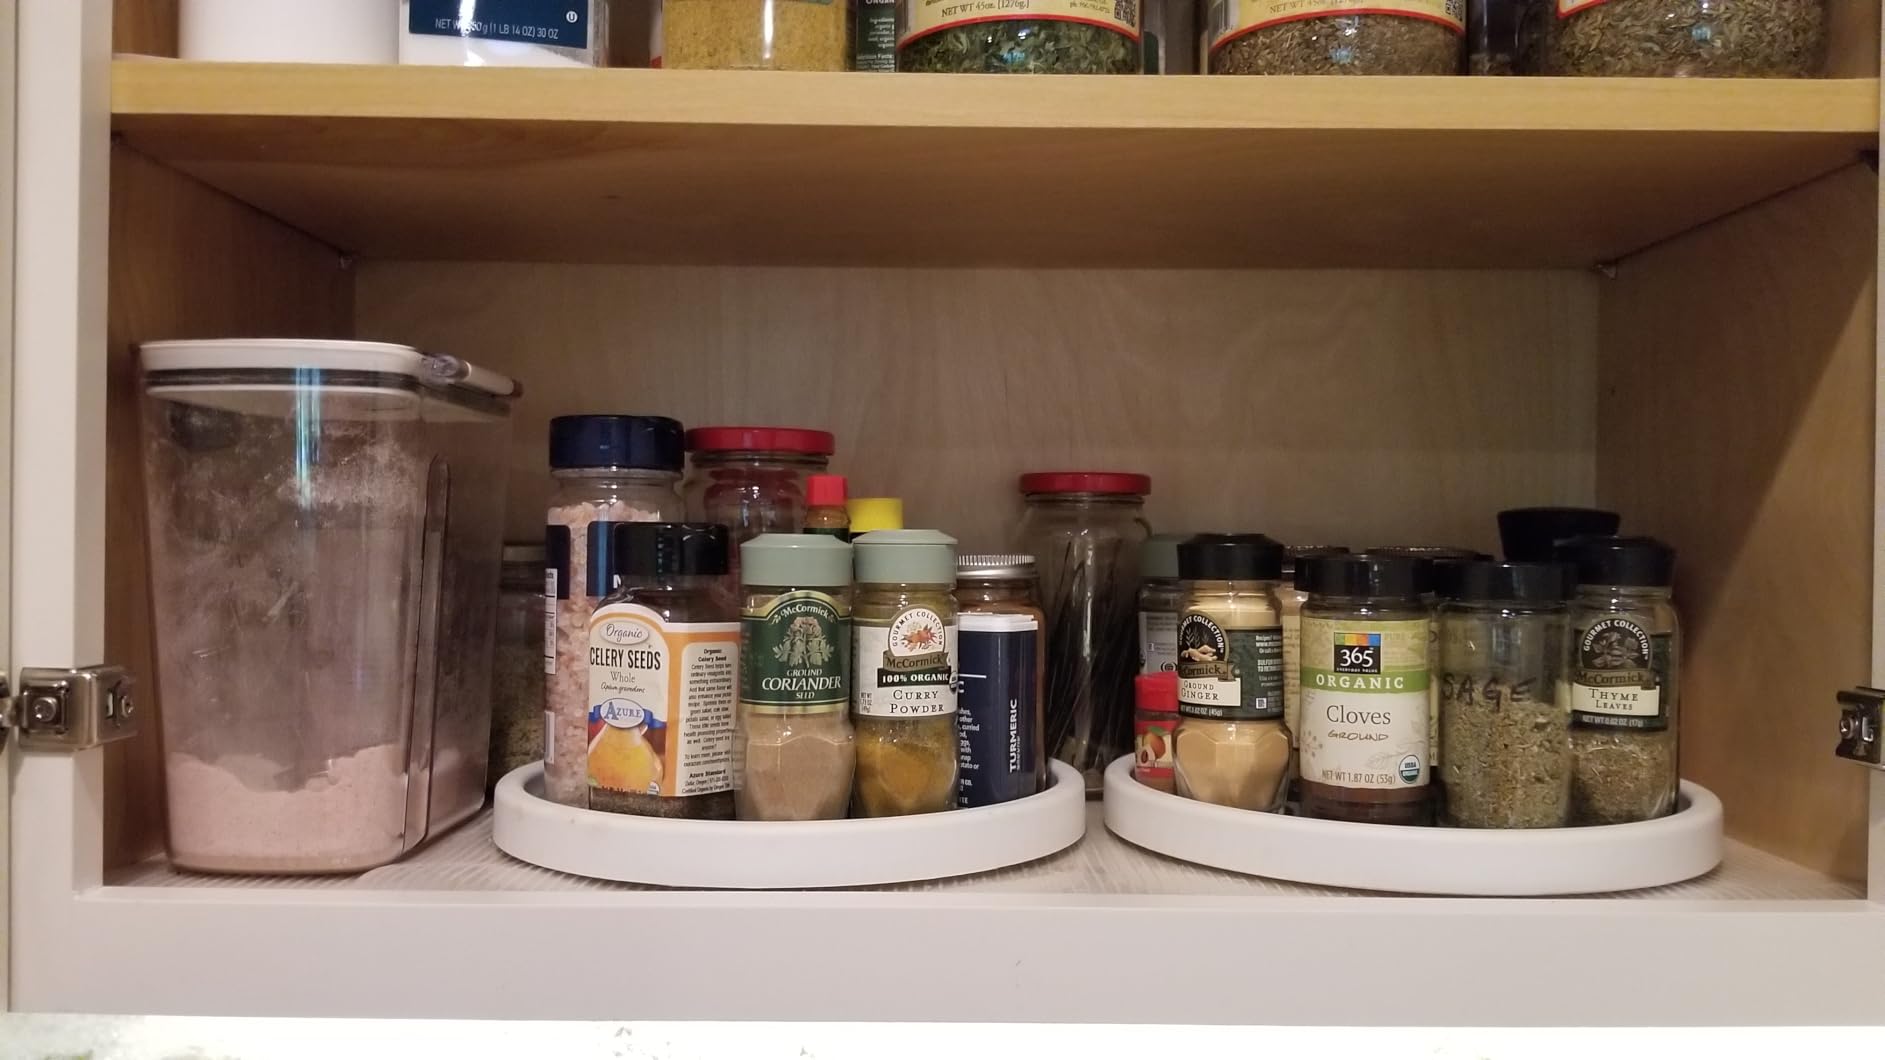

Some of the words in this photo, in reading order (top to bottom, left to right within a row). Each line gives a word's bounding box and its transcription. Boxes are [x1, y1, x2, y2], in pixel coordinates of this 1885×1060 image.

[942, 6, 958, 17] NET
[960, 3, 974, 13] WT
[1270, 2, 1287, 13] NET
[435, 18, 451, 30] NET
[500, 24, 509, 34] LB
[512, 25, 521, 35] 14
[537, 27, 547, 38] 30
[548, 28, 559, 39] OZ
[781, 604, 829, 618] McCormick
[606, 624, 643, 642] Organic
[892, 613, 913, 646] GOURMET
[917, 611, 943, 645] COLLECTION
[1193, 615, 1224, 648] COLLECTION
[1584, 620, 1611, 651] GOURMET
[1614, 620, 1648, 654] COLLECTION
[590, 647, 624, 667] CELERY
[627, 650, 661, 670] SEEDS
[886, 654, 943, 668] McCormick
[1340, 647, 1374, 667] 365
[611, 671, 636, 683] Whole
[762, 676, 841, 690] CORIANDER
[882, 674, 908, 683] 100%
[910, 673, 949, 681] ORGANIC
[1316, 674, 1404, 689] ORGANIC
[1578, 671, 1643, 684] McCormick
[1184, 680, 1214, 690] GROUND
[1181, 688, 1219, 700] GINGER
[1588, 688, 1638, 701] THYME
[1596, 700, 1632, 710] LEAVES
[1326, 705, 1391, 725] Cloves
[1010, 699, 1018, 773] TURMERIC
[1328, 730, 1389, 741] GROUND
[1322, 770, 1333, 780] NET
[1335, 772, 1346, 781] WT
[1348, 773, 1362, 782] 1.87
[1365, 774, 1374, 784] OZ
[1377, 774, 1396, 785] (53g)
